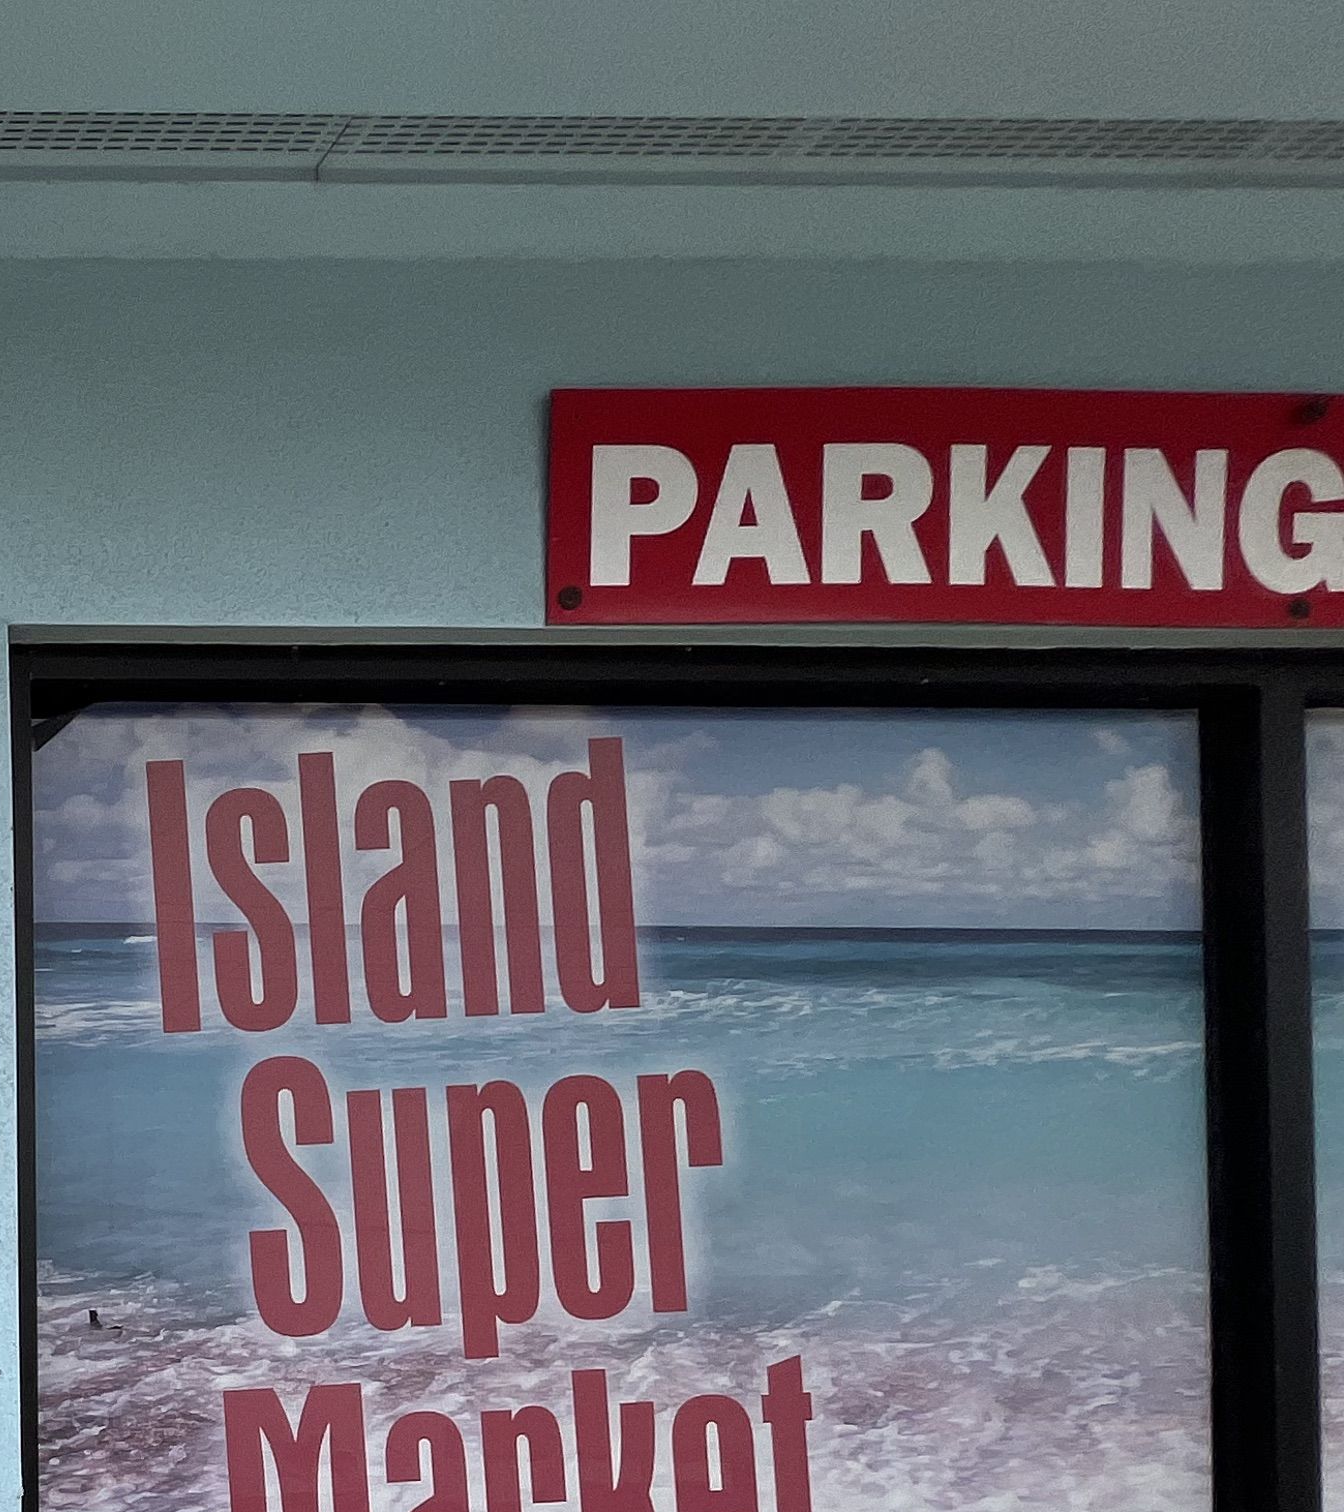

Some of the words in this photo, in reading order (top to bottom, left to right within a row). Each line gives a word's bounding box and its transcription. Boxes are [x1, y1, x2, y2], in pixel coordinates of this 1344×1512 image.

[589, 442, 1344, 595] PARKING
[144, 736, 640, 1034] Island
[239, 1055, 724, 1360] Super
